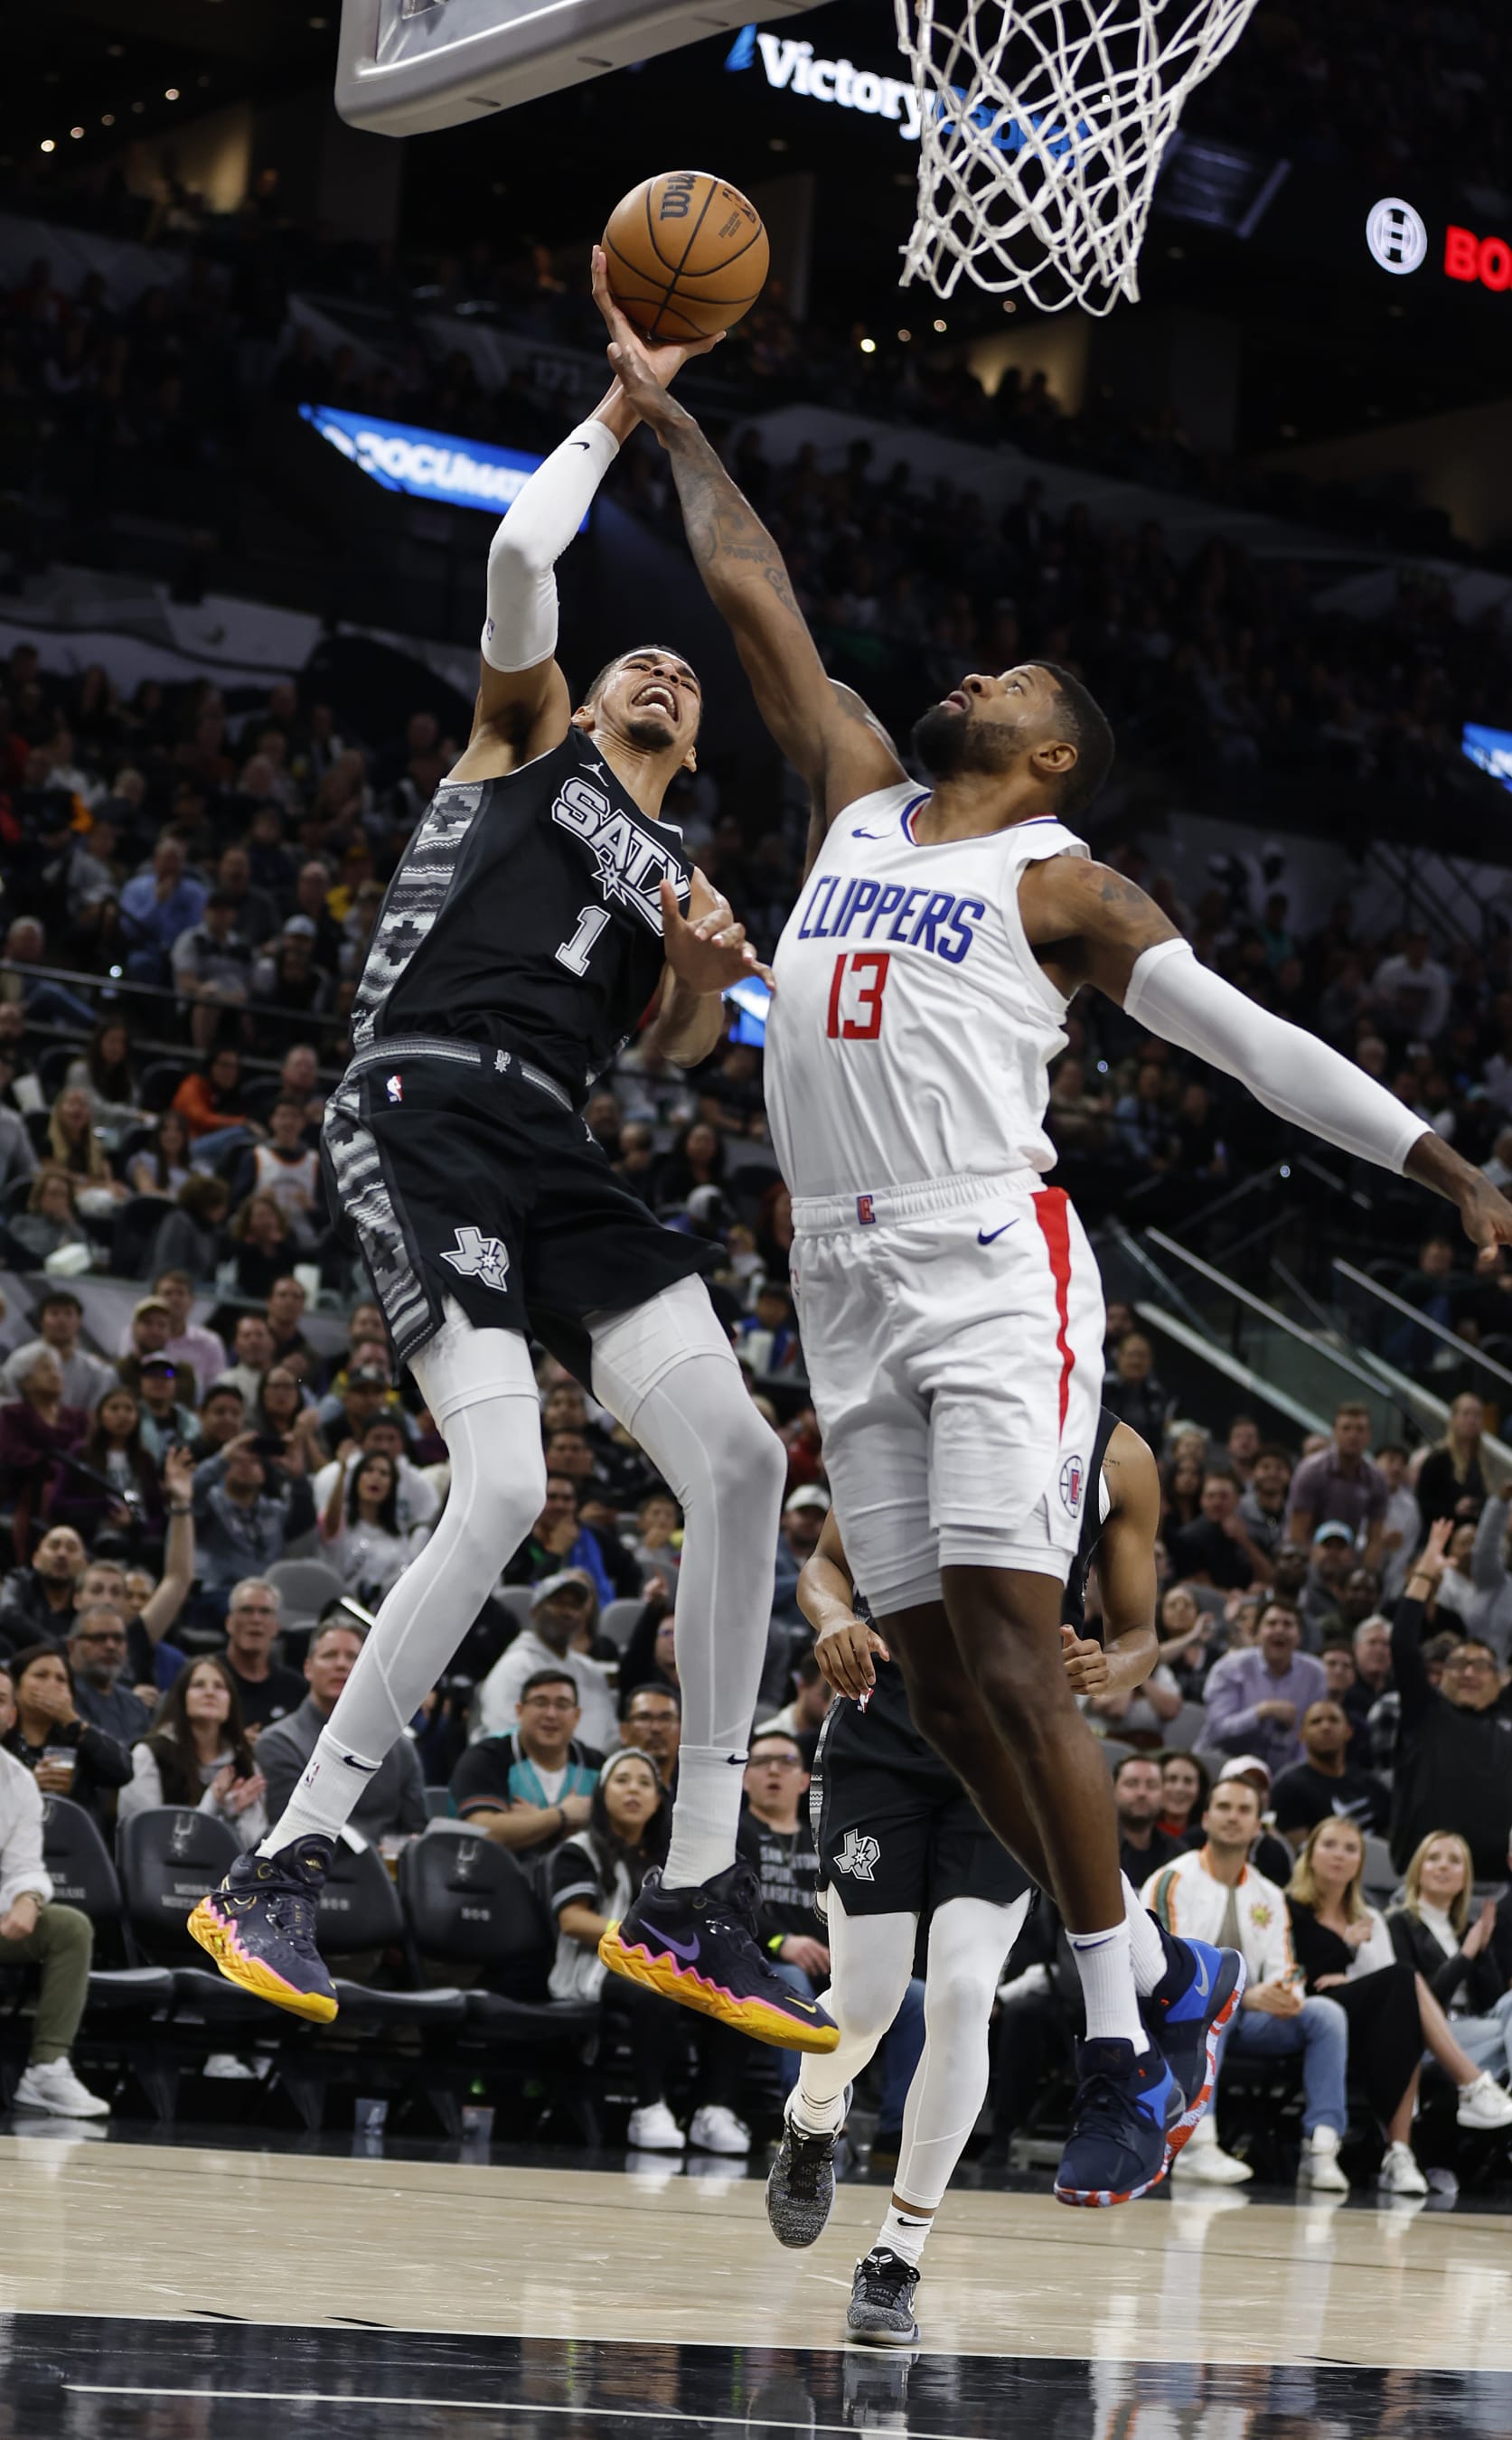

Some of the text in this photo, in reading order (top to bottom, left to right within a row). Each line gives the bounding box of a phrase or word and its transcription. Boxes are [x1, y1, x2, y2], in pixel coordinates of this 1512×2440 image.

[756, 33, 937, 141] Victory
[555, 906, 611, 977] 1
[797, 875, 986, 964] CLIPPERS
[827, 953, 890, 1040] 13
